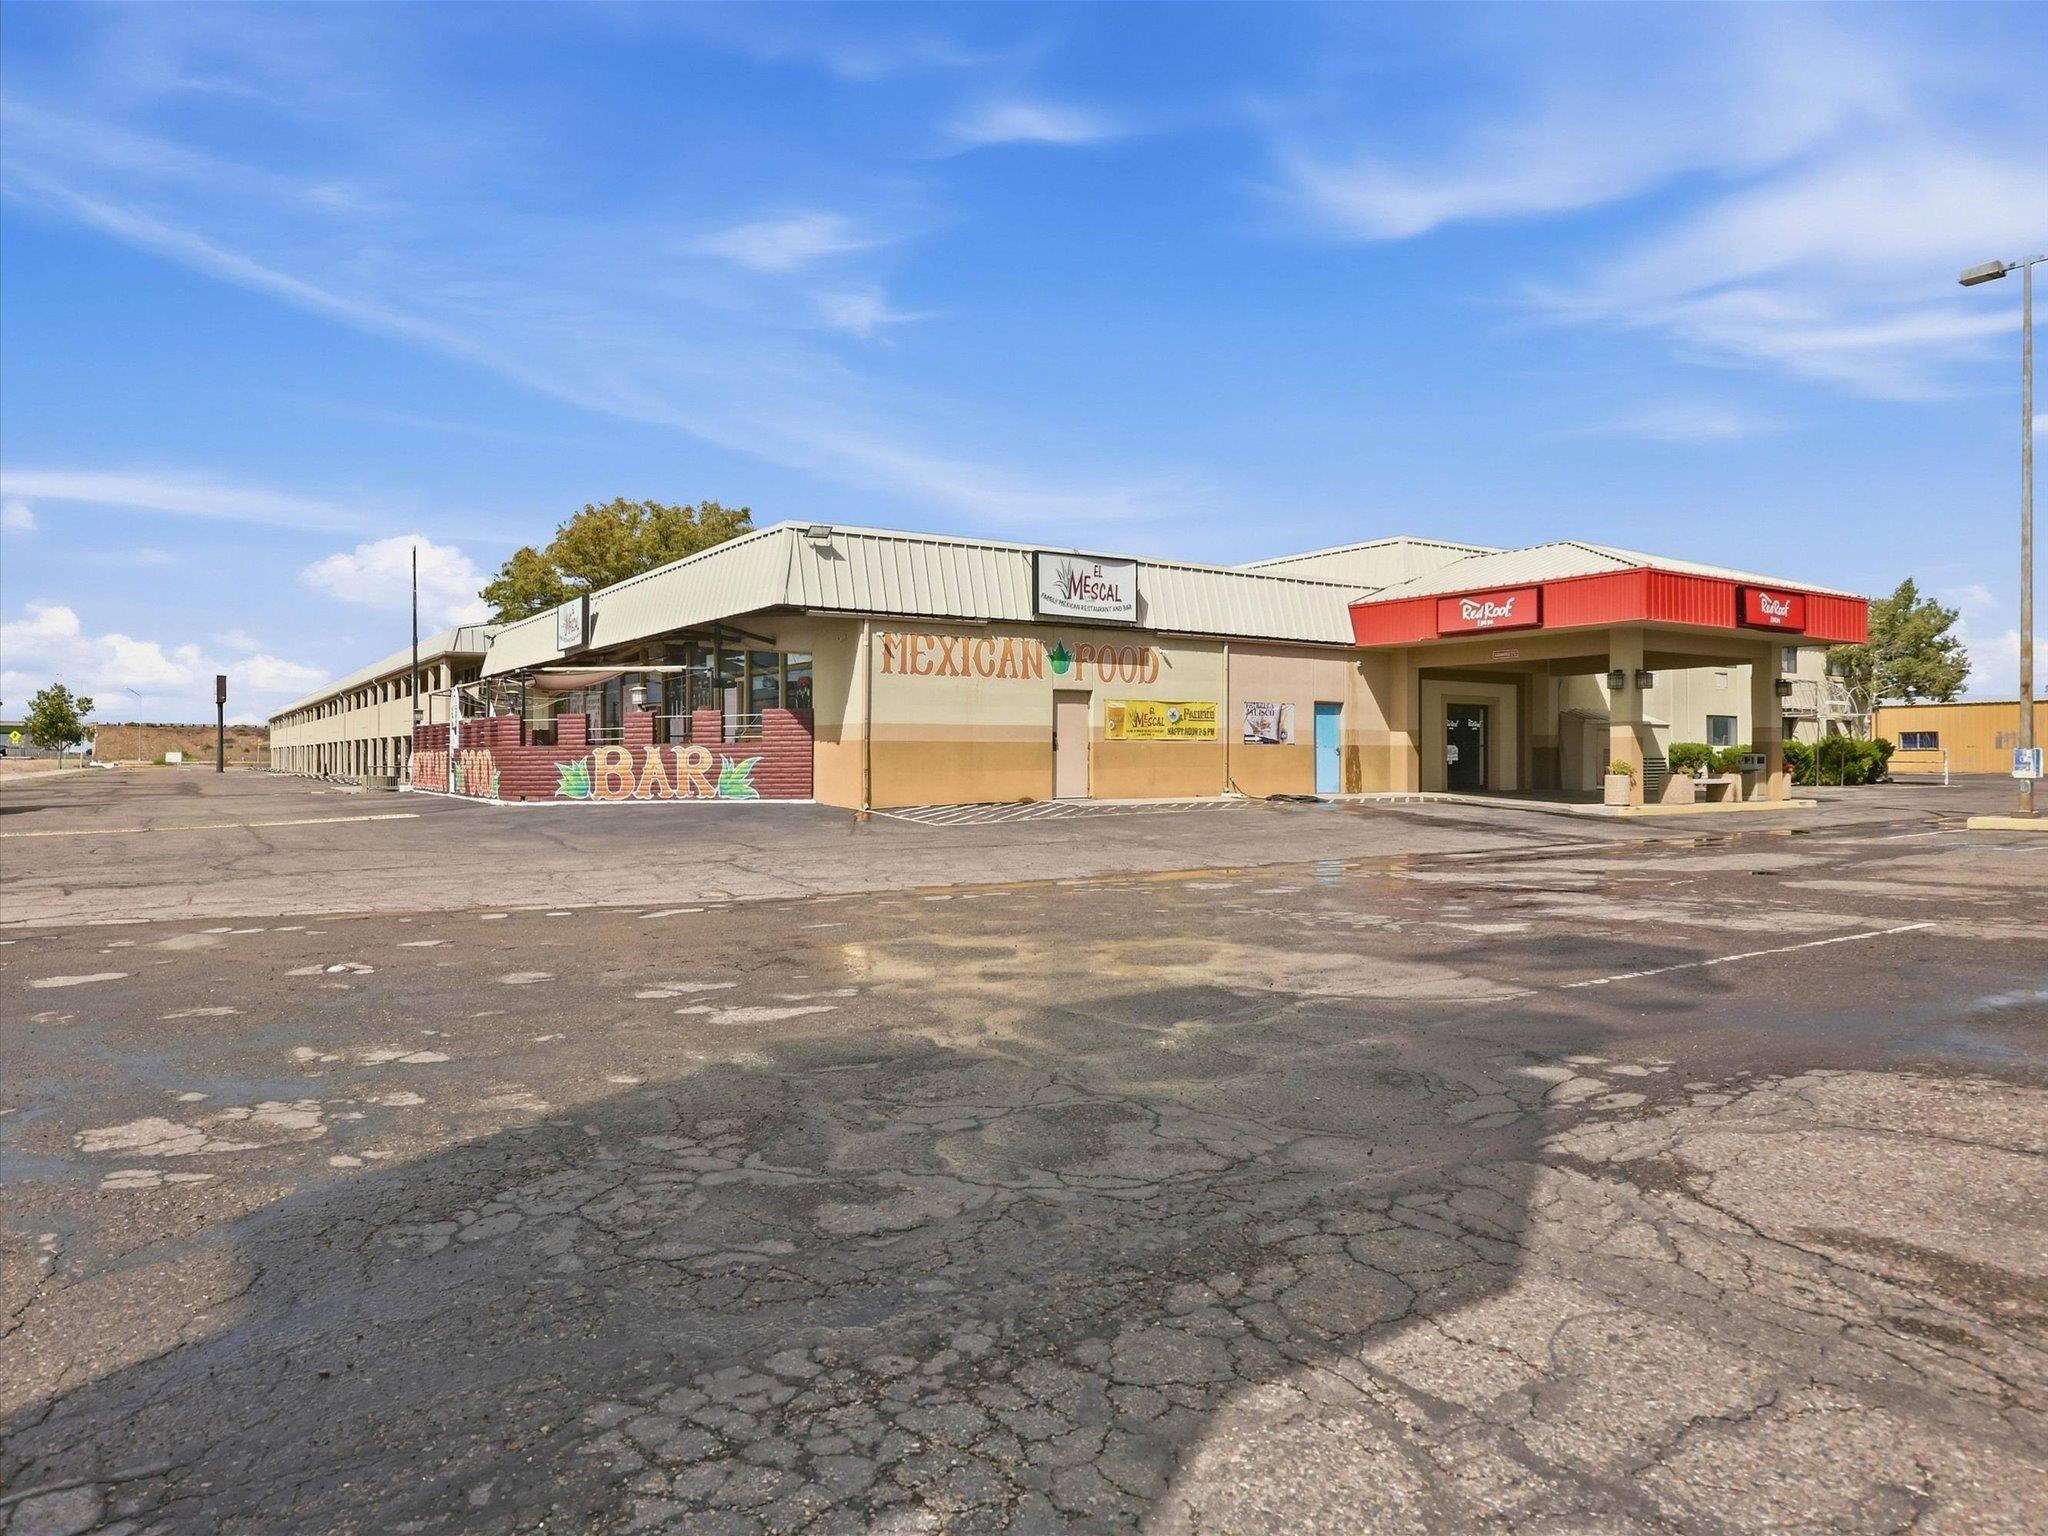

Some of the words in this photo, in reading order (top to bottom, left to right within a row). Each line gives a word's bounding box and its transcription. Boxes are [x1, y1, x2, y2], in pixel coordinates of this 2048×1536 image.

[1093, 564, 1103, 578] EL
[1067, 569, 1122, 602] MESCAL
[1041, 592, 1059, 604] FAMILY
[1058, 600, 1081, 611] MEXICAN
[1081, 604, 1112, 613] RESTAURANT
[1112, 604, 1122, 612] AND
[1122, 603, 1132, 611] BAR
[880, 632, 1045, 680] MEXICAN
[1073, 642, 1160, 684] FOOD
[1135, 711, 1165, 728] MESCAL
[592, 746, 720, 800] BAR
